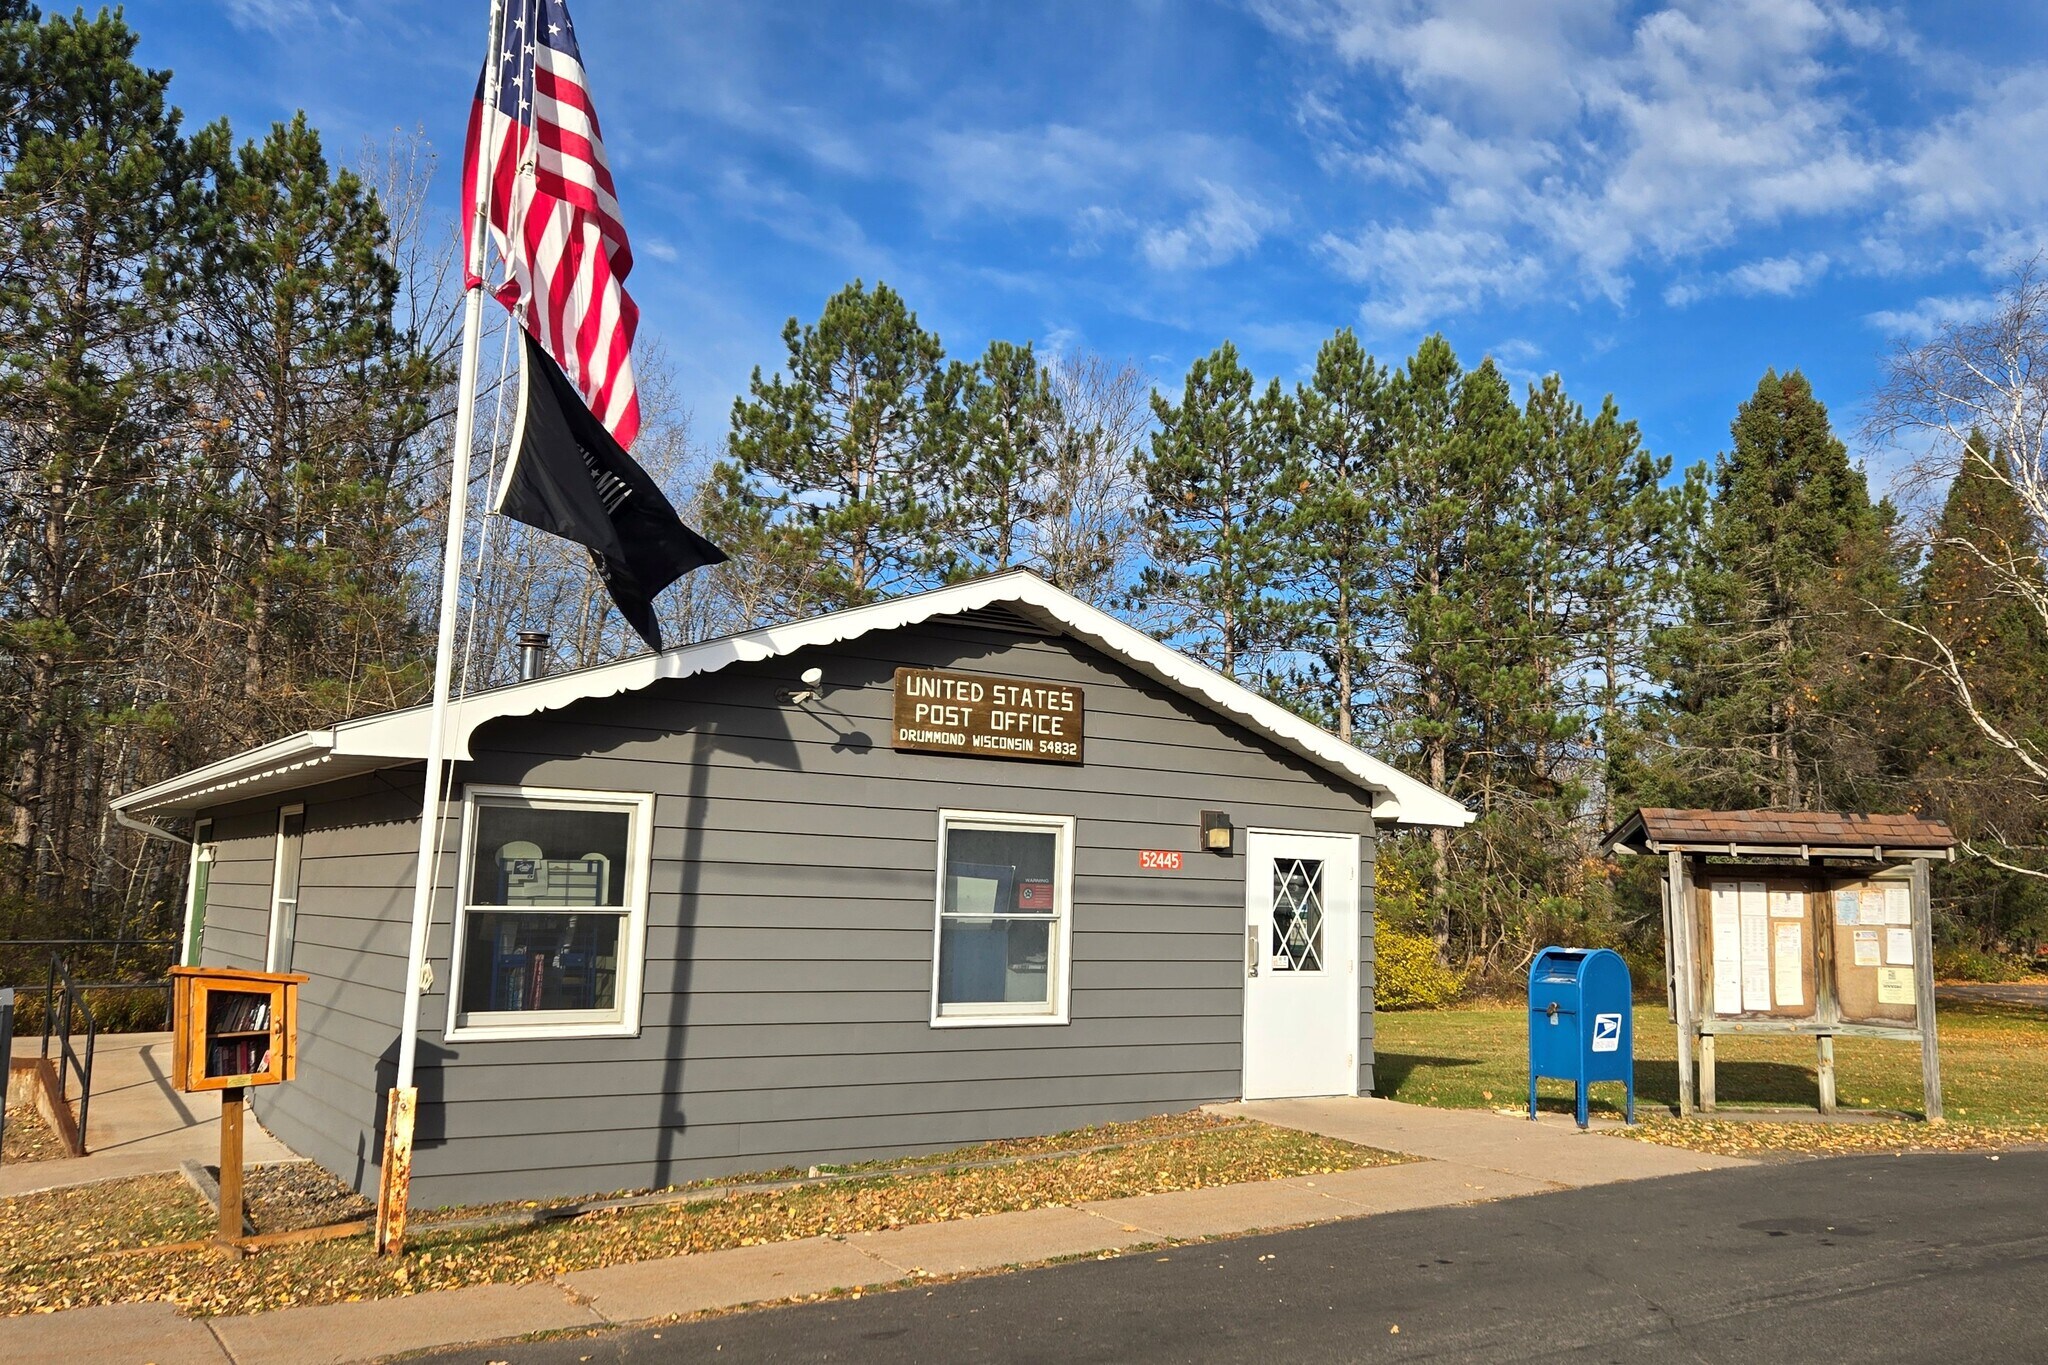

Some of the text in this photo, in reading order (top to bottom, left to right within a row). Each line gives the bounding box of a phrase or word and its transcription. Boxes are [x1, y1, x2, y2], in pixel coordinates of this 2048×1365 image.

[906, 675, 1073, 712] UNITED STATES
[915, 703, 1064, 736] POST OFFICE
[900, 728, 1077, 756] DRUMMOND WISCONSIN 54832
[1142, 851, 1179, 869] 52445
